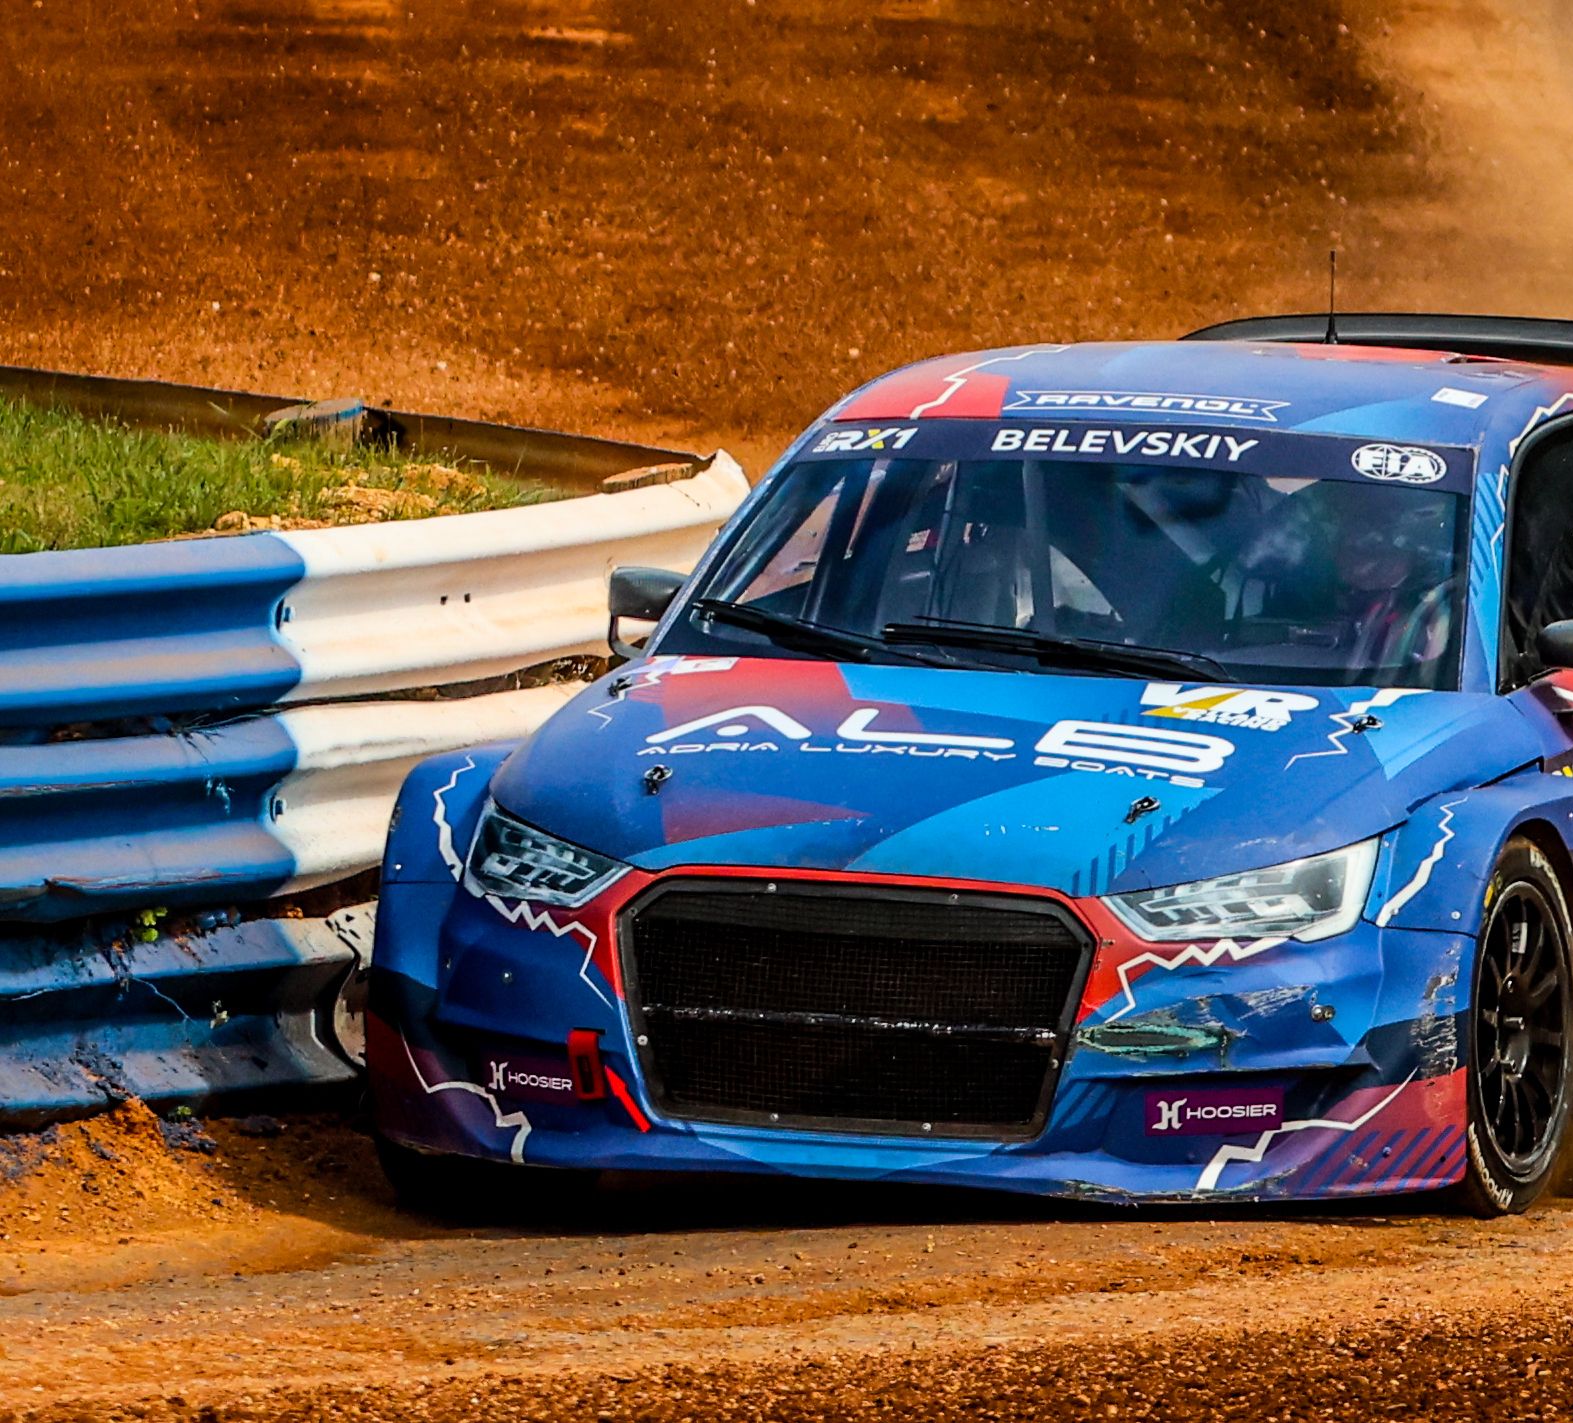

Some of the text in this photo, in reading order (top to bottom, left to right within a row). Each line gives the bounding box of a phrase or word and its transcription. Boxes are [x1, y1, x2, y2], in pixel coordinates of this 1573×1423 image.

[1035, 394, 1259, 414] RAVENOL
[825, 427, 919, 452] RX1
[990, 429, 1260, 462] BELEVSKIY
[1358, 449, 1437, 480] FIA
[635, 742, 1207, 789] ADRIA LUXURY BOATS
[507, 1070, 573, 1091] HOOSIER
[1185, 1103, 1277, 1120] HOOSIER
